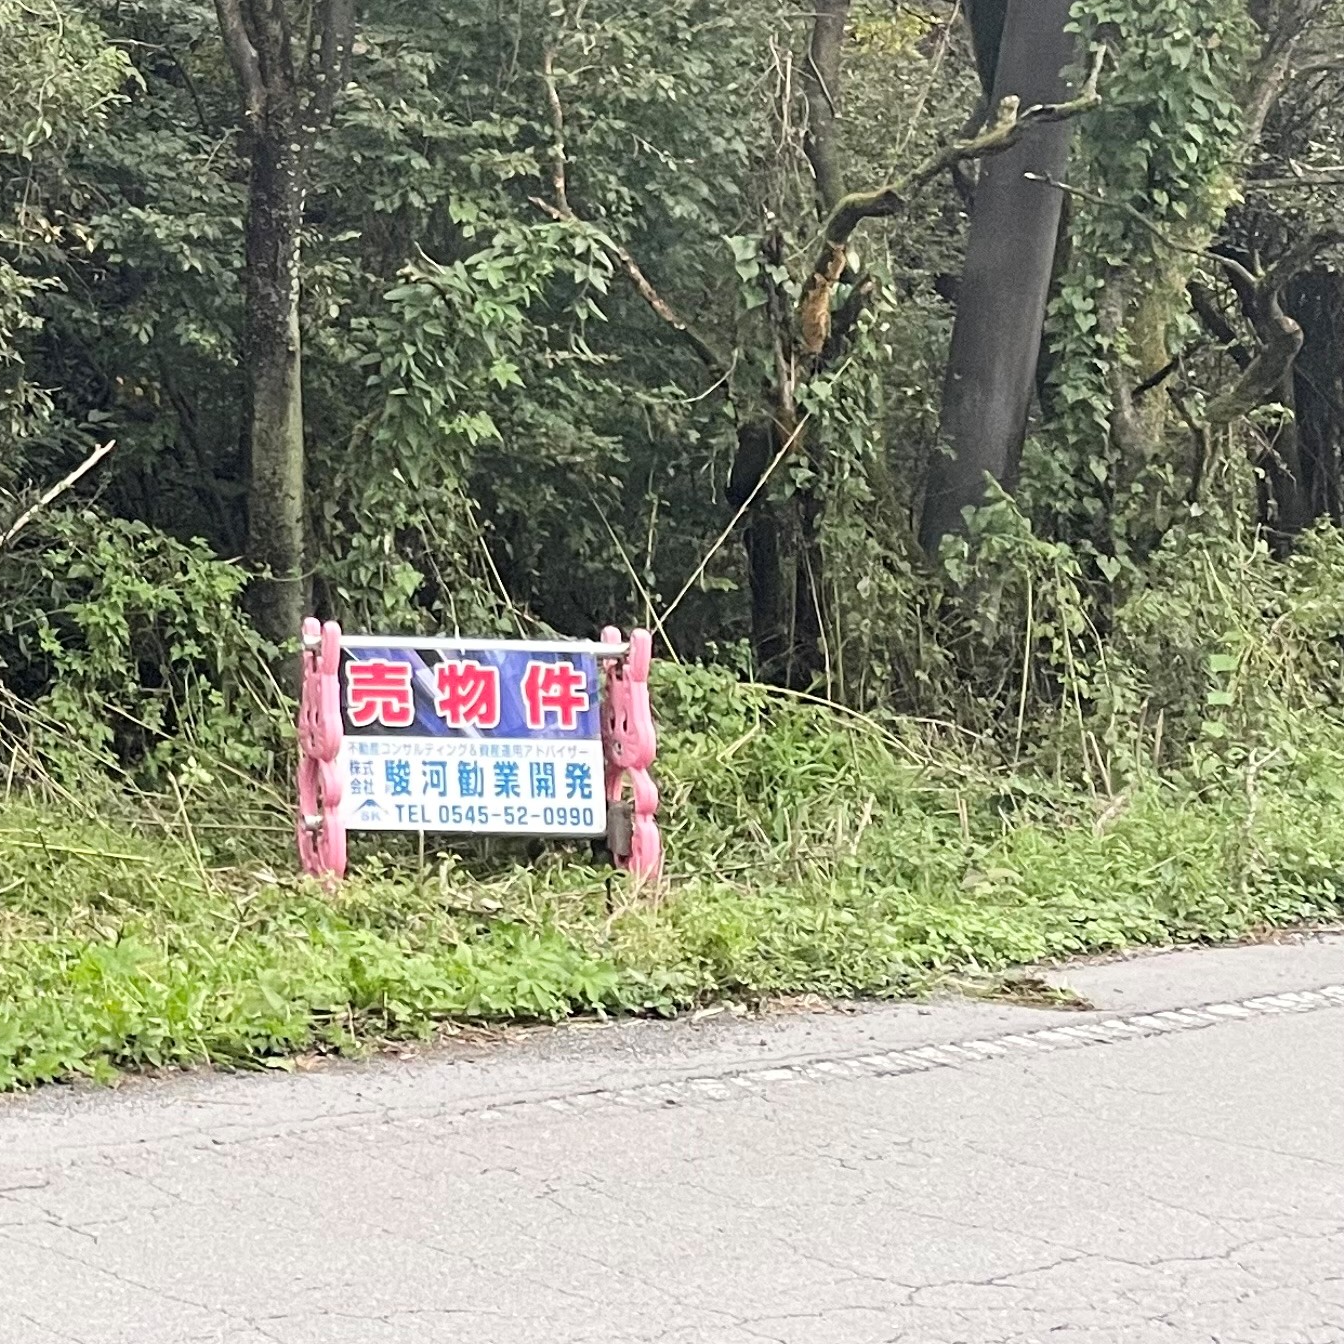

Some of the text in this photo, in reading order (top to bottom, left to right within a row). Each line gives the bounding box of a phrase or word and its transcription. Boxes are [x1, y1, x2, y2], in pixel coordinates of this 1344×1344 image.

[346, 659, 590, 730] 売物件
[395, 804, 593, 826] TEL 0545-52-0990
